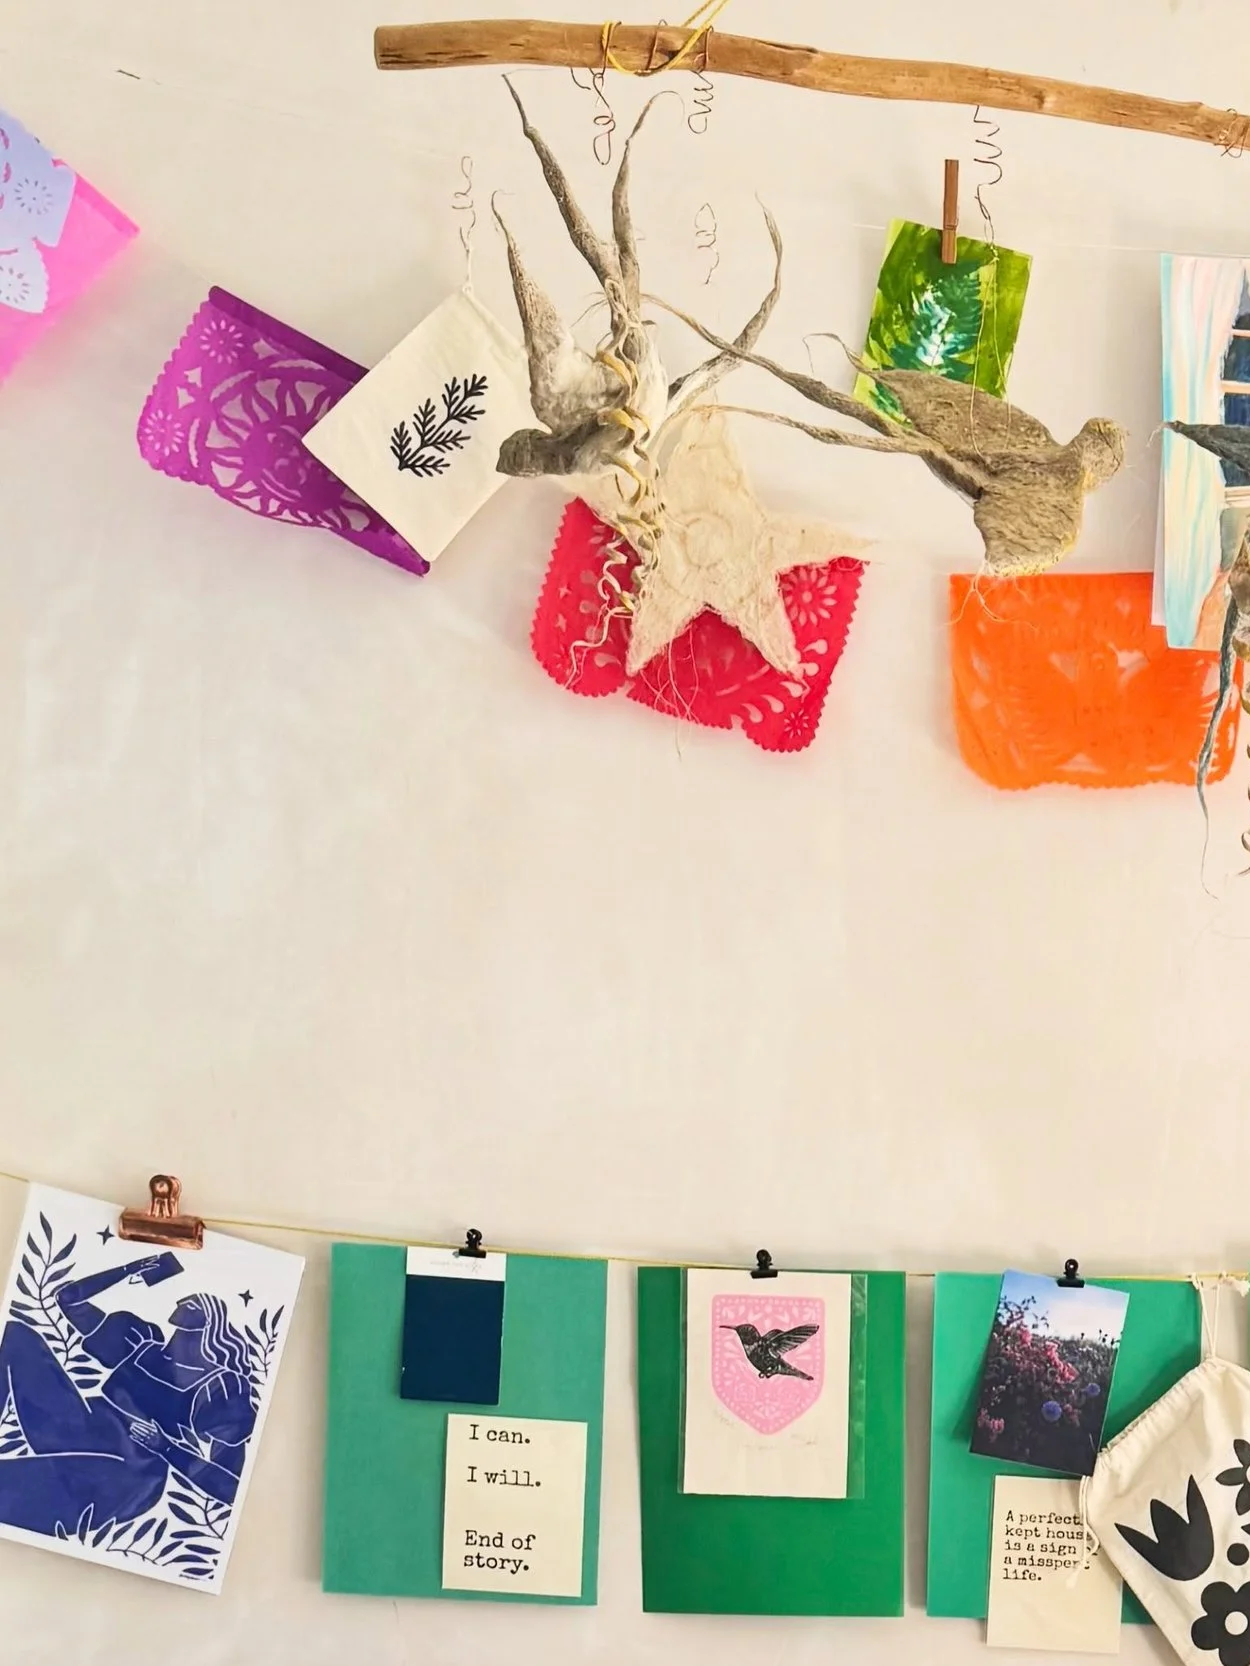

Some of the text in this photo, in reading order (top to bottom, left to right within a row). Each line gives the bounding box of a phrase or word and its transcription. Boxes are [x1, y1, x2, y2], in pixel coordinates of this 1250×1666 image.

[469, 1424, 531, 1444] I can.
[467, 1466, 541, 1487] I will.
[1005, 1509, 1014, 1522] A
[464, 1529, 537, 1550] End of
[1005, 1524, 1041, 1539] kept
[1004, 1539, 1021, 1551] is
[1026, 1542, 1035, 1552] a
[1040, 1542, 1077, 1556] sign
[463, 1552, 530, 1575] story.
[1003, 1556, 1012, 1565] a
[1002, 1568, 1042, 1581] life.
